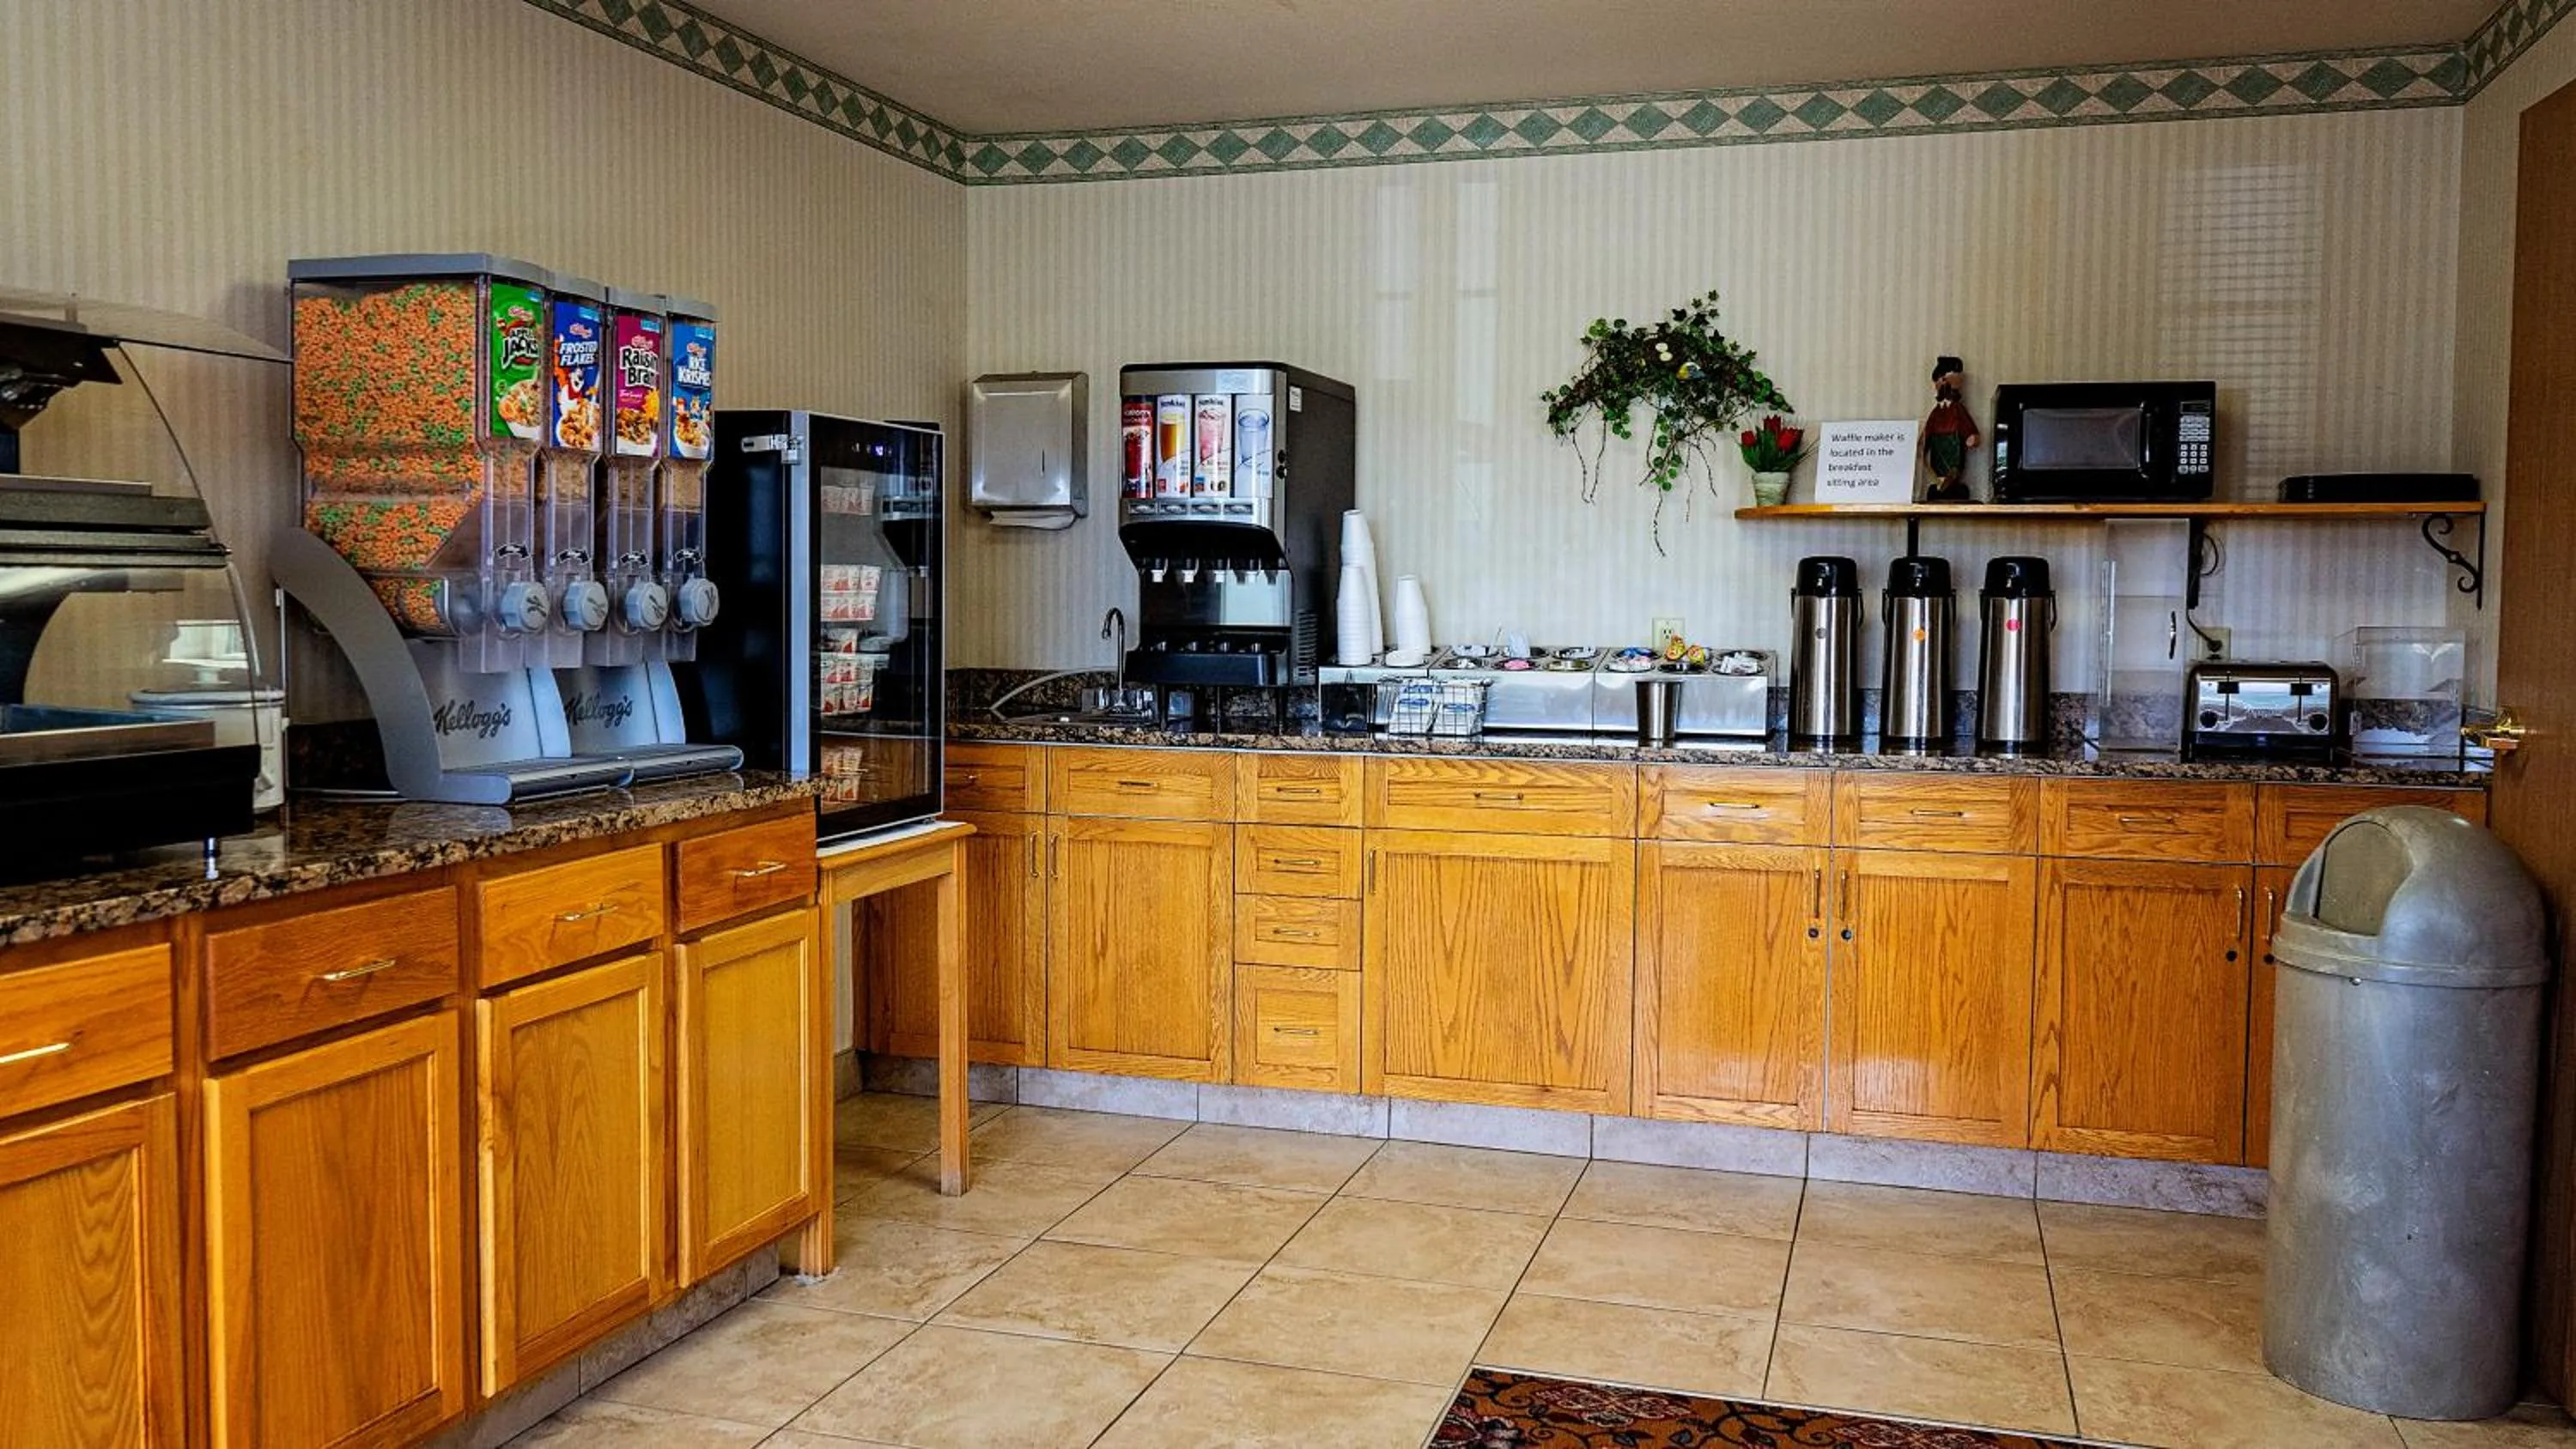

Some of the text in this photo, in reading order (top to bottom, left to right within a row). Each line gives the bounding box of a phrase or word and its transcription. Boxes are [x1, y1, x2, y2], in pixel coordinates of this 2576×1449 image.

[560, 353, 595, 367] FLAKES
[1831, 432, 1905, 442] Waffle maker is
[1829, 447, 1894, 458] located in the
[1828, 463, 1872, 471] breakfast
[1858, 478, 1880, 487] area
[563, 692, 634, 728] Kellogg's
[433, 700, 512, 738] Kellogg's
